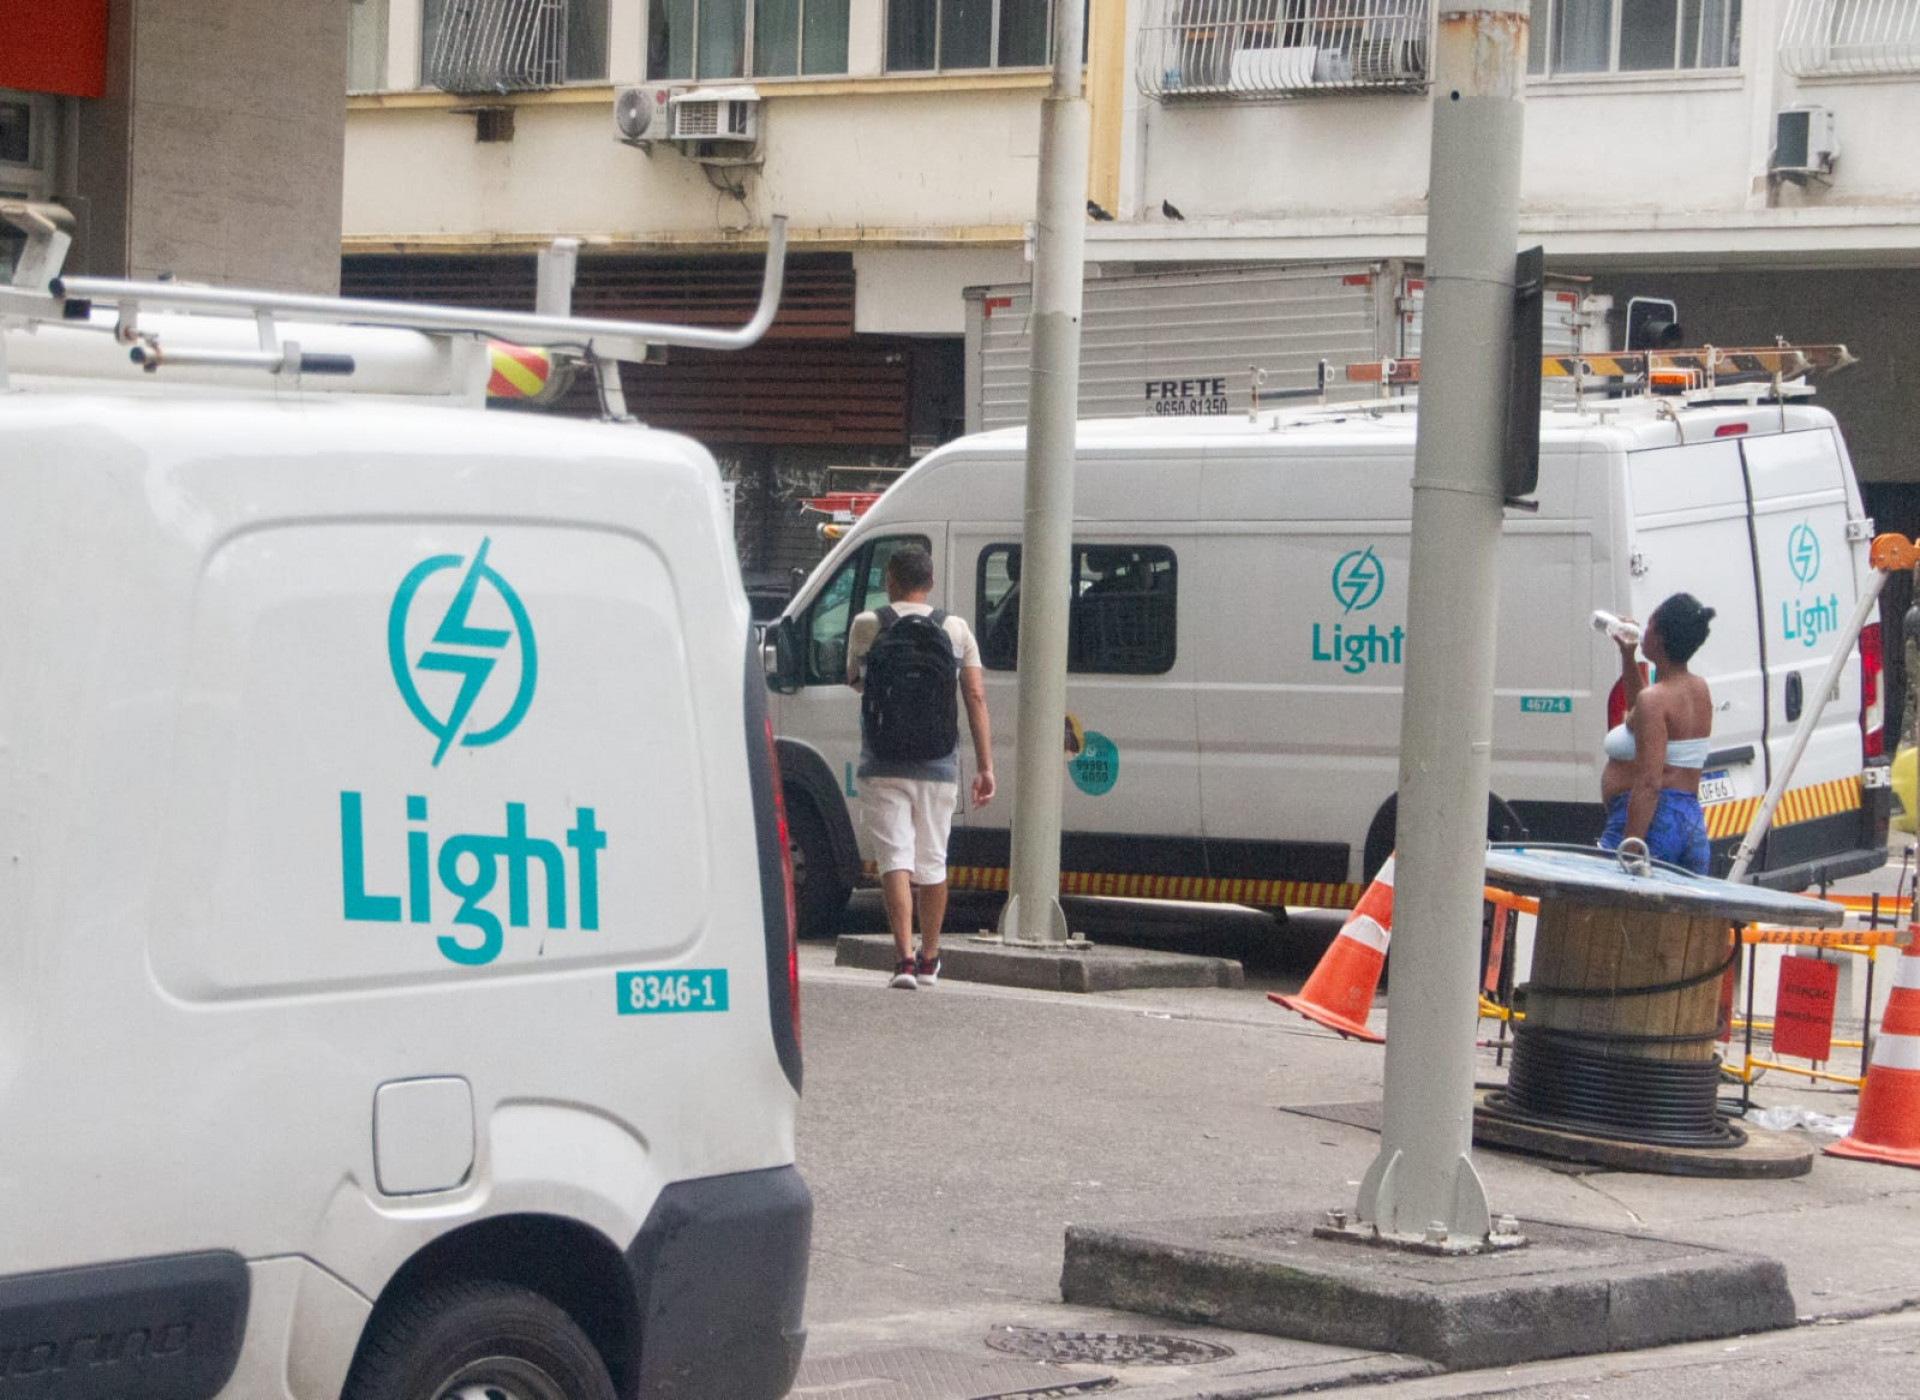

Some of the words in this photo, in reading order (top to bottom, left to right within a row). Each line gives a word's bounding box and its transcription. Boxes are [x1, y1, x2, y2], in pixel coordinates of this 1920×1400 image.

[1145, 378, 1226, 400] FRETE
[1781, 593, 1839, 648] Light
[1312, 622, 1405, 674] Light
[340, 790, 607, 967] Light
[1759, 932, 1864, 946] AFASTE-SE
[630, 975, 716, 1009] 8346-1
